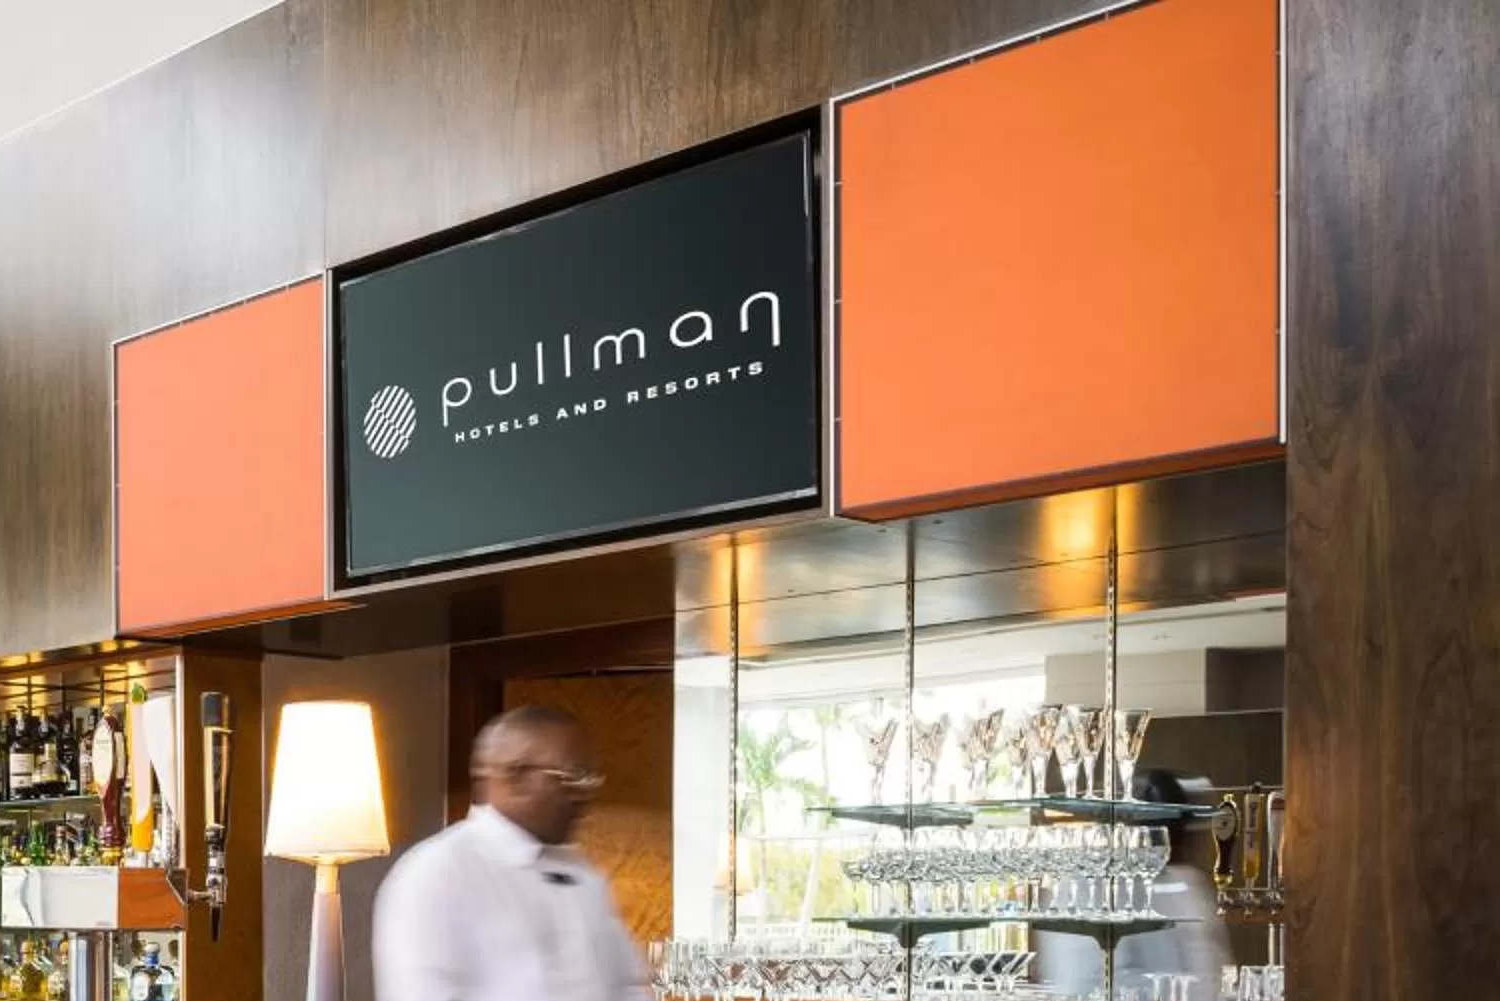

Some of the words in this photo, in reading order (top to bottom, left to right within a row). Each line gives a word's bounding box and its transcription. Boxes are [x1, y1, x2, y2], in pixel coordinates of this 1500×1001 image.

[441, 290, 781, 428] pullman
[454, 413, 541, 444] HOTELS
[556, 398, 608, 420] AND
[627, 360, 765, 404] RESORTS
